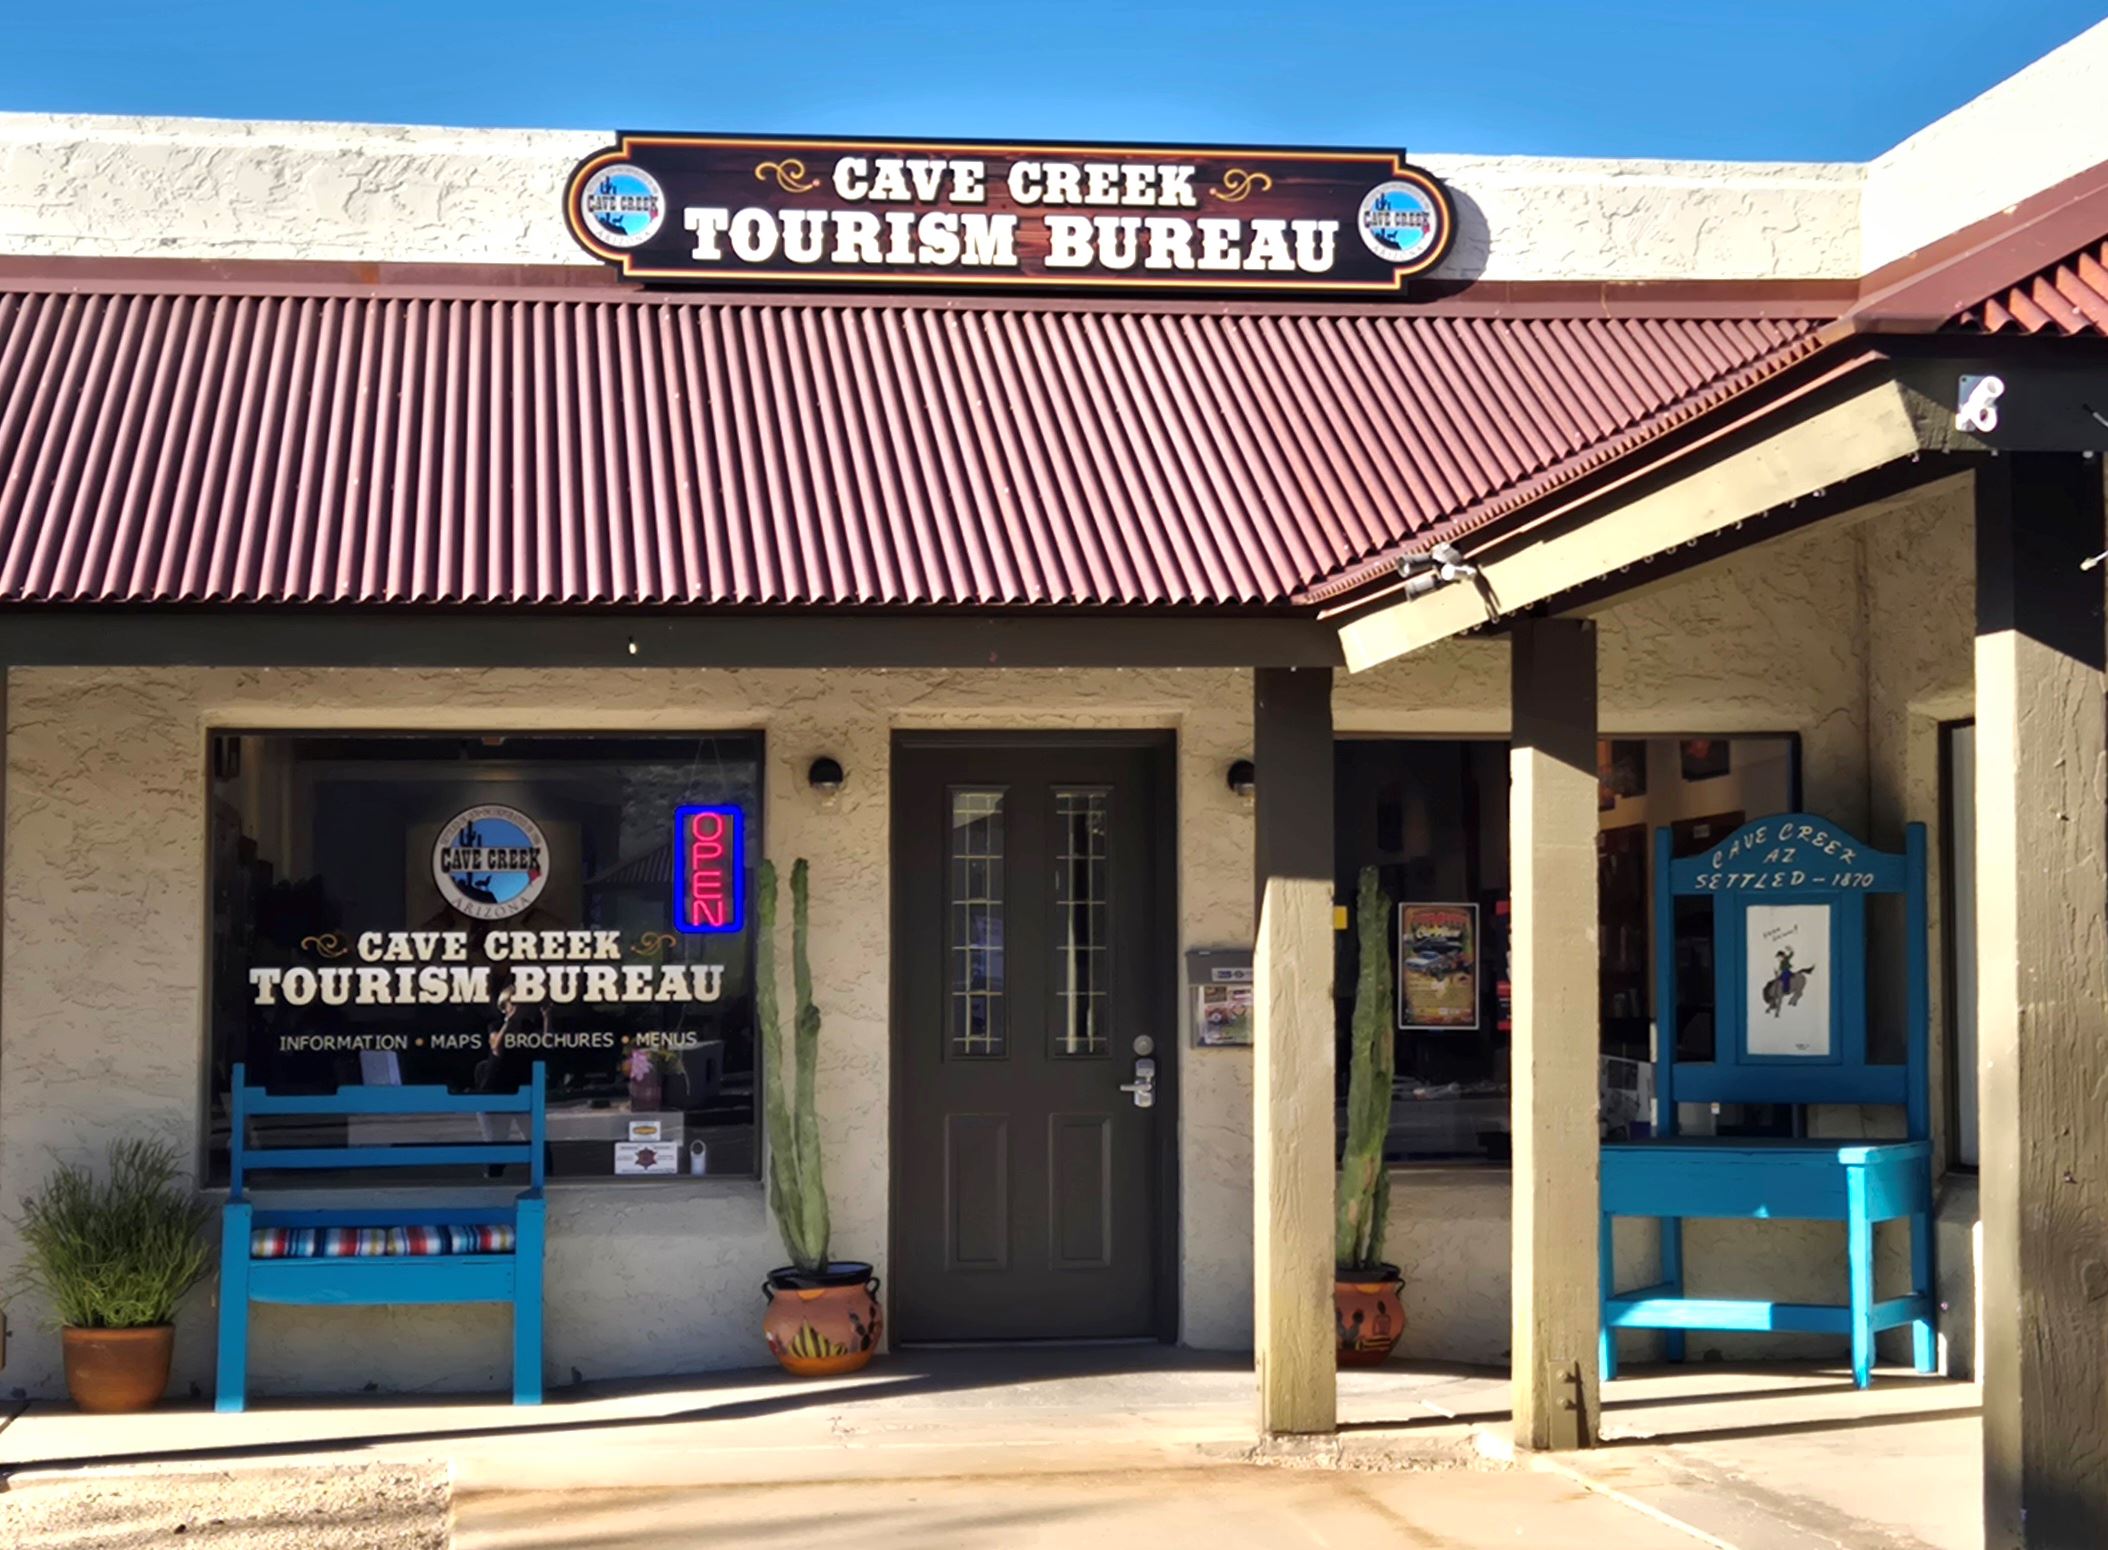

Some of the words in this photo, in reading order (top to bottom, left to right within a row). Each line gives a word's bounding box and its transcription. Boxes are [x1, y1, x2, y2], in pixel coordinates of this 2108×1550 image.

[833, 156, 985, 202] CAVE
[1007, 161, 1197, 207] CREEK
[588, 194, 616, 212] CAVE
[620, 194, 658, 211] CREEK
[1363, 210, 1391, 229] CAVE
[1395, 210, 1430, 228] CREEK
[683, 207, 1018, 267] TOURISM
[1044, 215, 1340, 273] BUREAU
[1712, 826, 1768, 869] CAVE
[1778, 822, 1857, 864] CREEK
[1763, 848, 1797, 863] AZ
[441, 847, 482, 873] CAVE
[487, 847, 541, 870] CREEK
[692, 811, 724, 927] OPEN
[1695, 871, 1806, 889] SETTLED
[1831, 872, 1875, 888] 1870
[453, 896, 530, 919] ARIZONA
[357, 931, 467, 962] CAVE
[484, 930, 622, 961] CREEK
[249, 966, 491, 1005] TOURISM
[509, 964, 725, 1003] BUREAU
[280, 1035, 408, 1051] INFORMATION
[430, 1034, 482, 1049] MAPS
[504, 1032, 615, 1049] BROCHURES
[636, 1031, 699, 1047] MENUS
